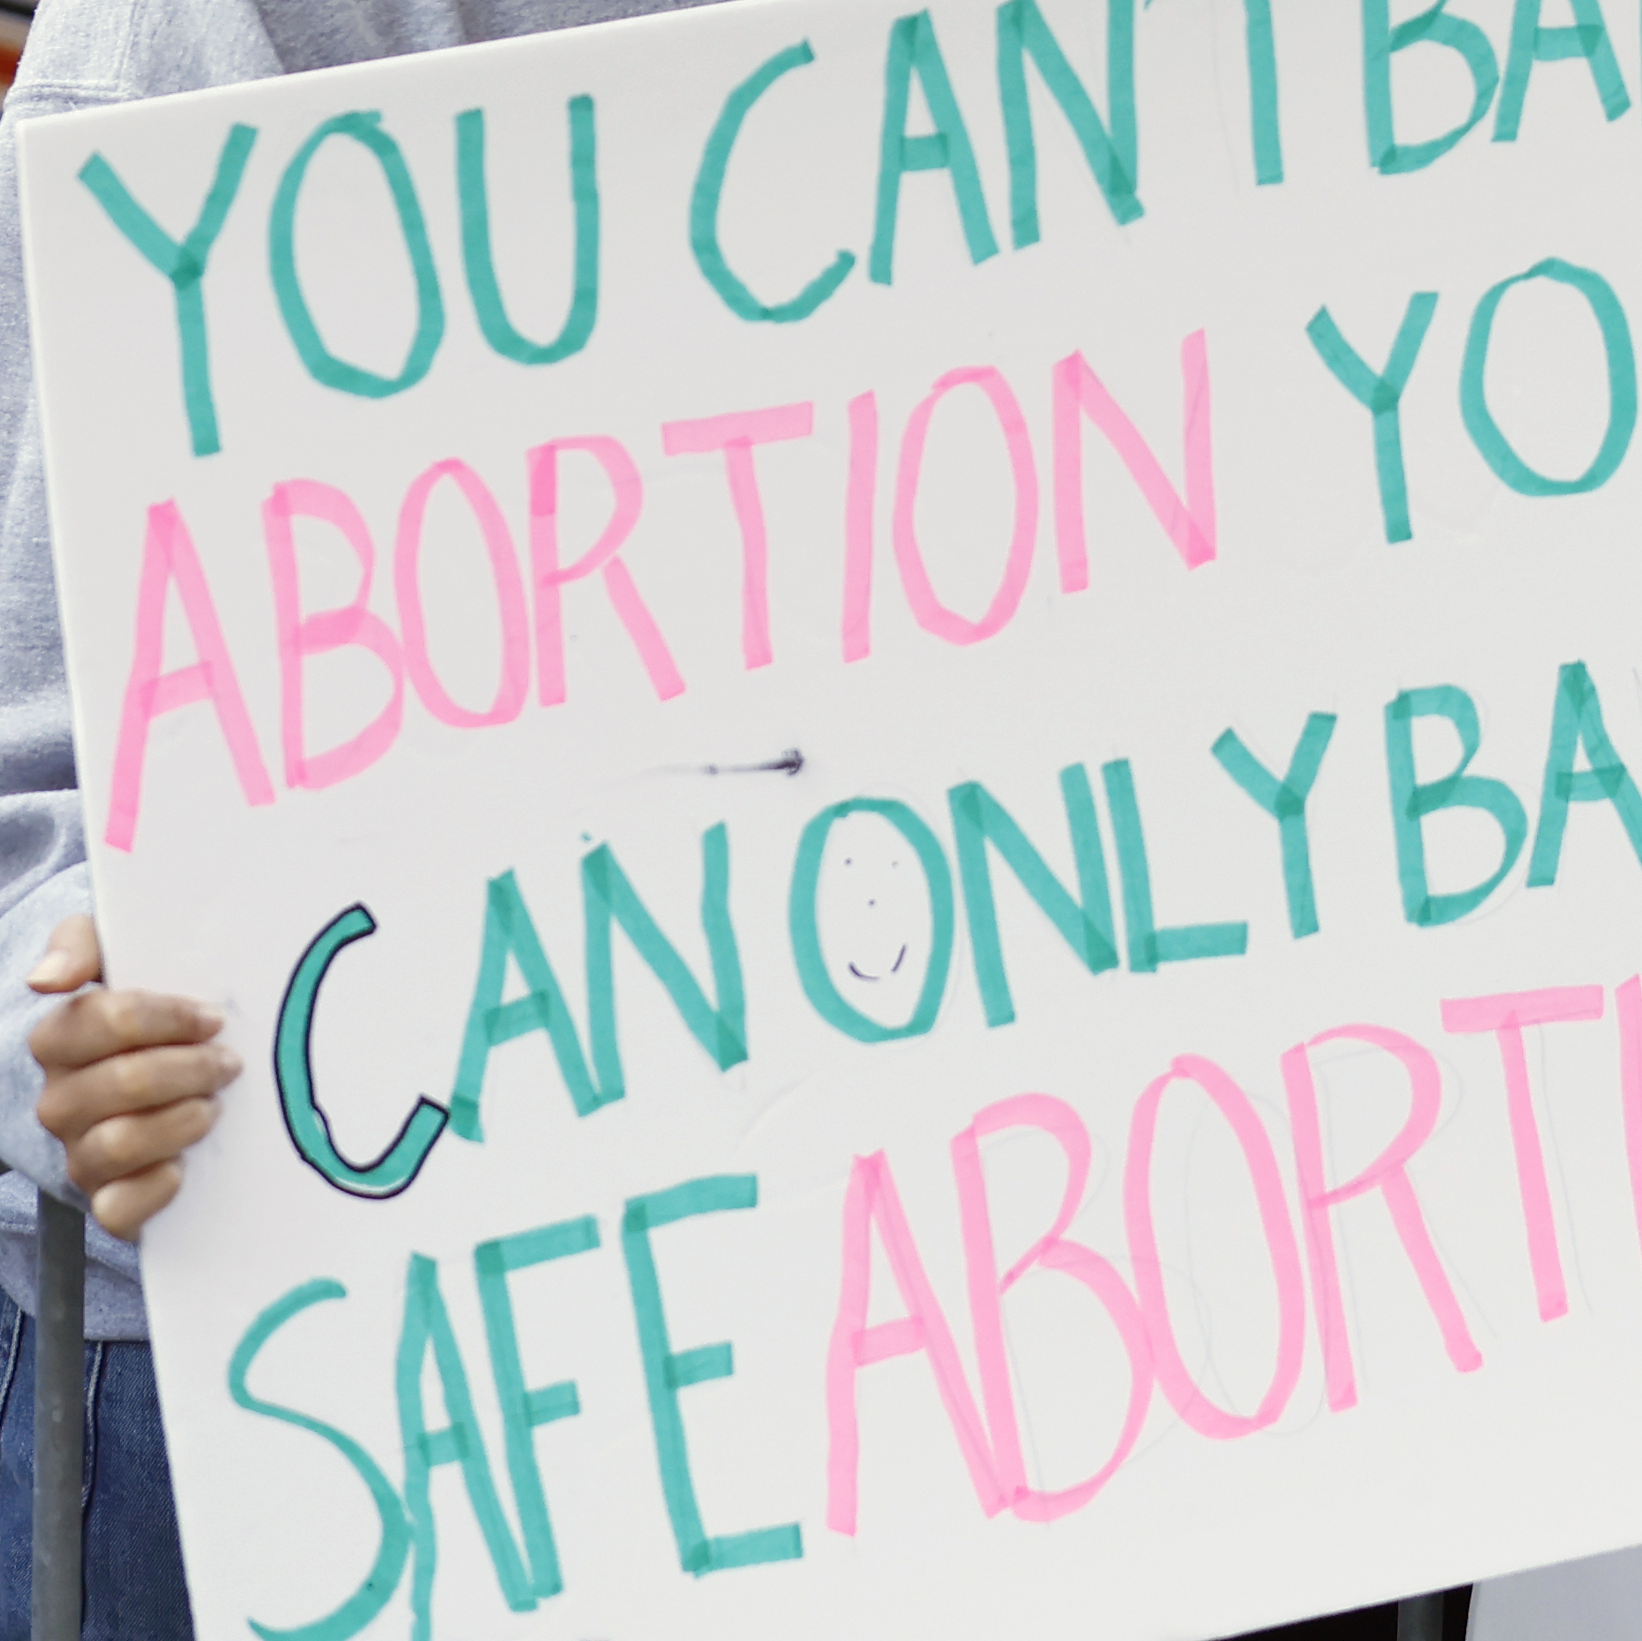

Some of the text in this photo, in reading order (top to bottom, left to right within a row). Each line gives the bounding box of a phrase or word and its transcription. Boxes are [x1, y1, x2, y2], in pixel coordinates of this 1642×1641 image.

[78, 95, 600, 458] YOU
[101, 329, 1218, 854] ABORTION
[273, 822, 749, 1199] CAN
[788, 711, 1338, 1044] ONLY
[228, 1172, 804, 1641] SAFE
